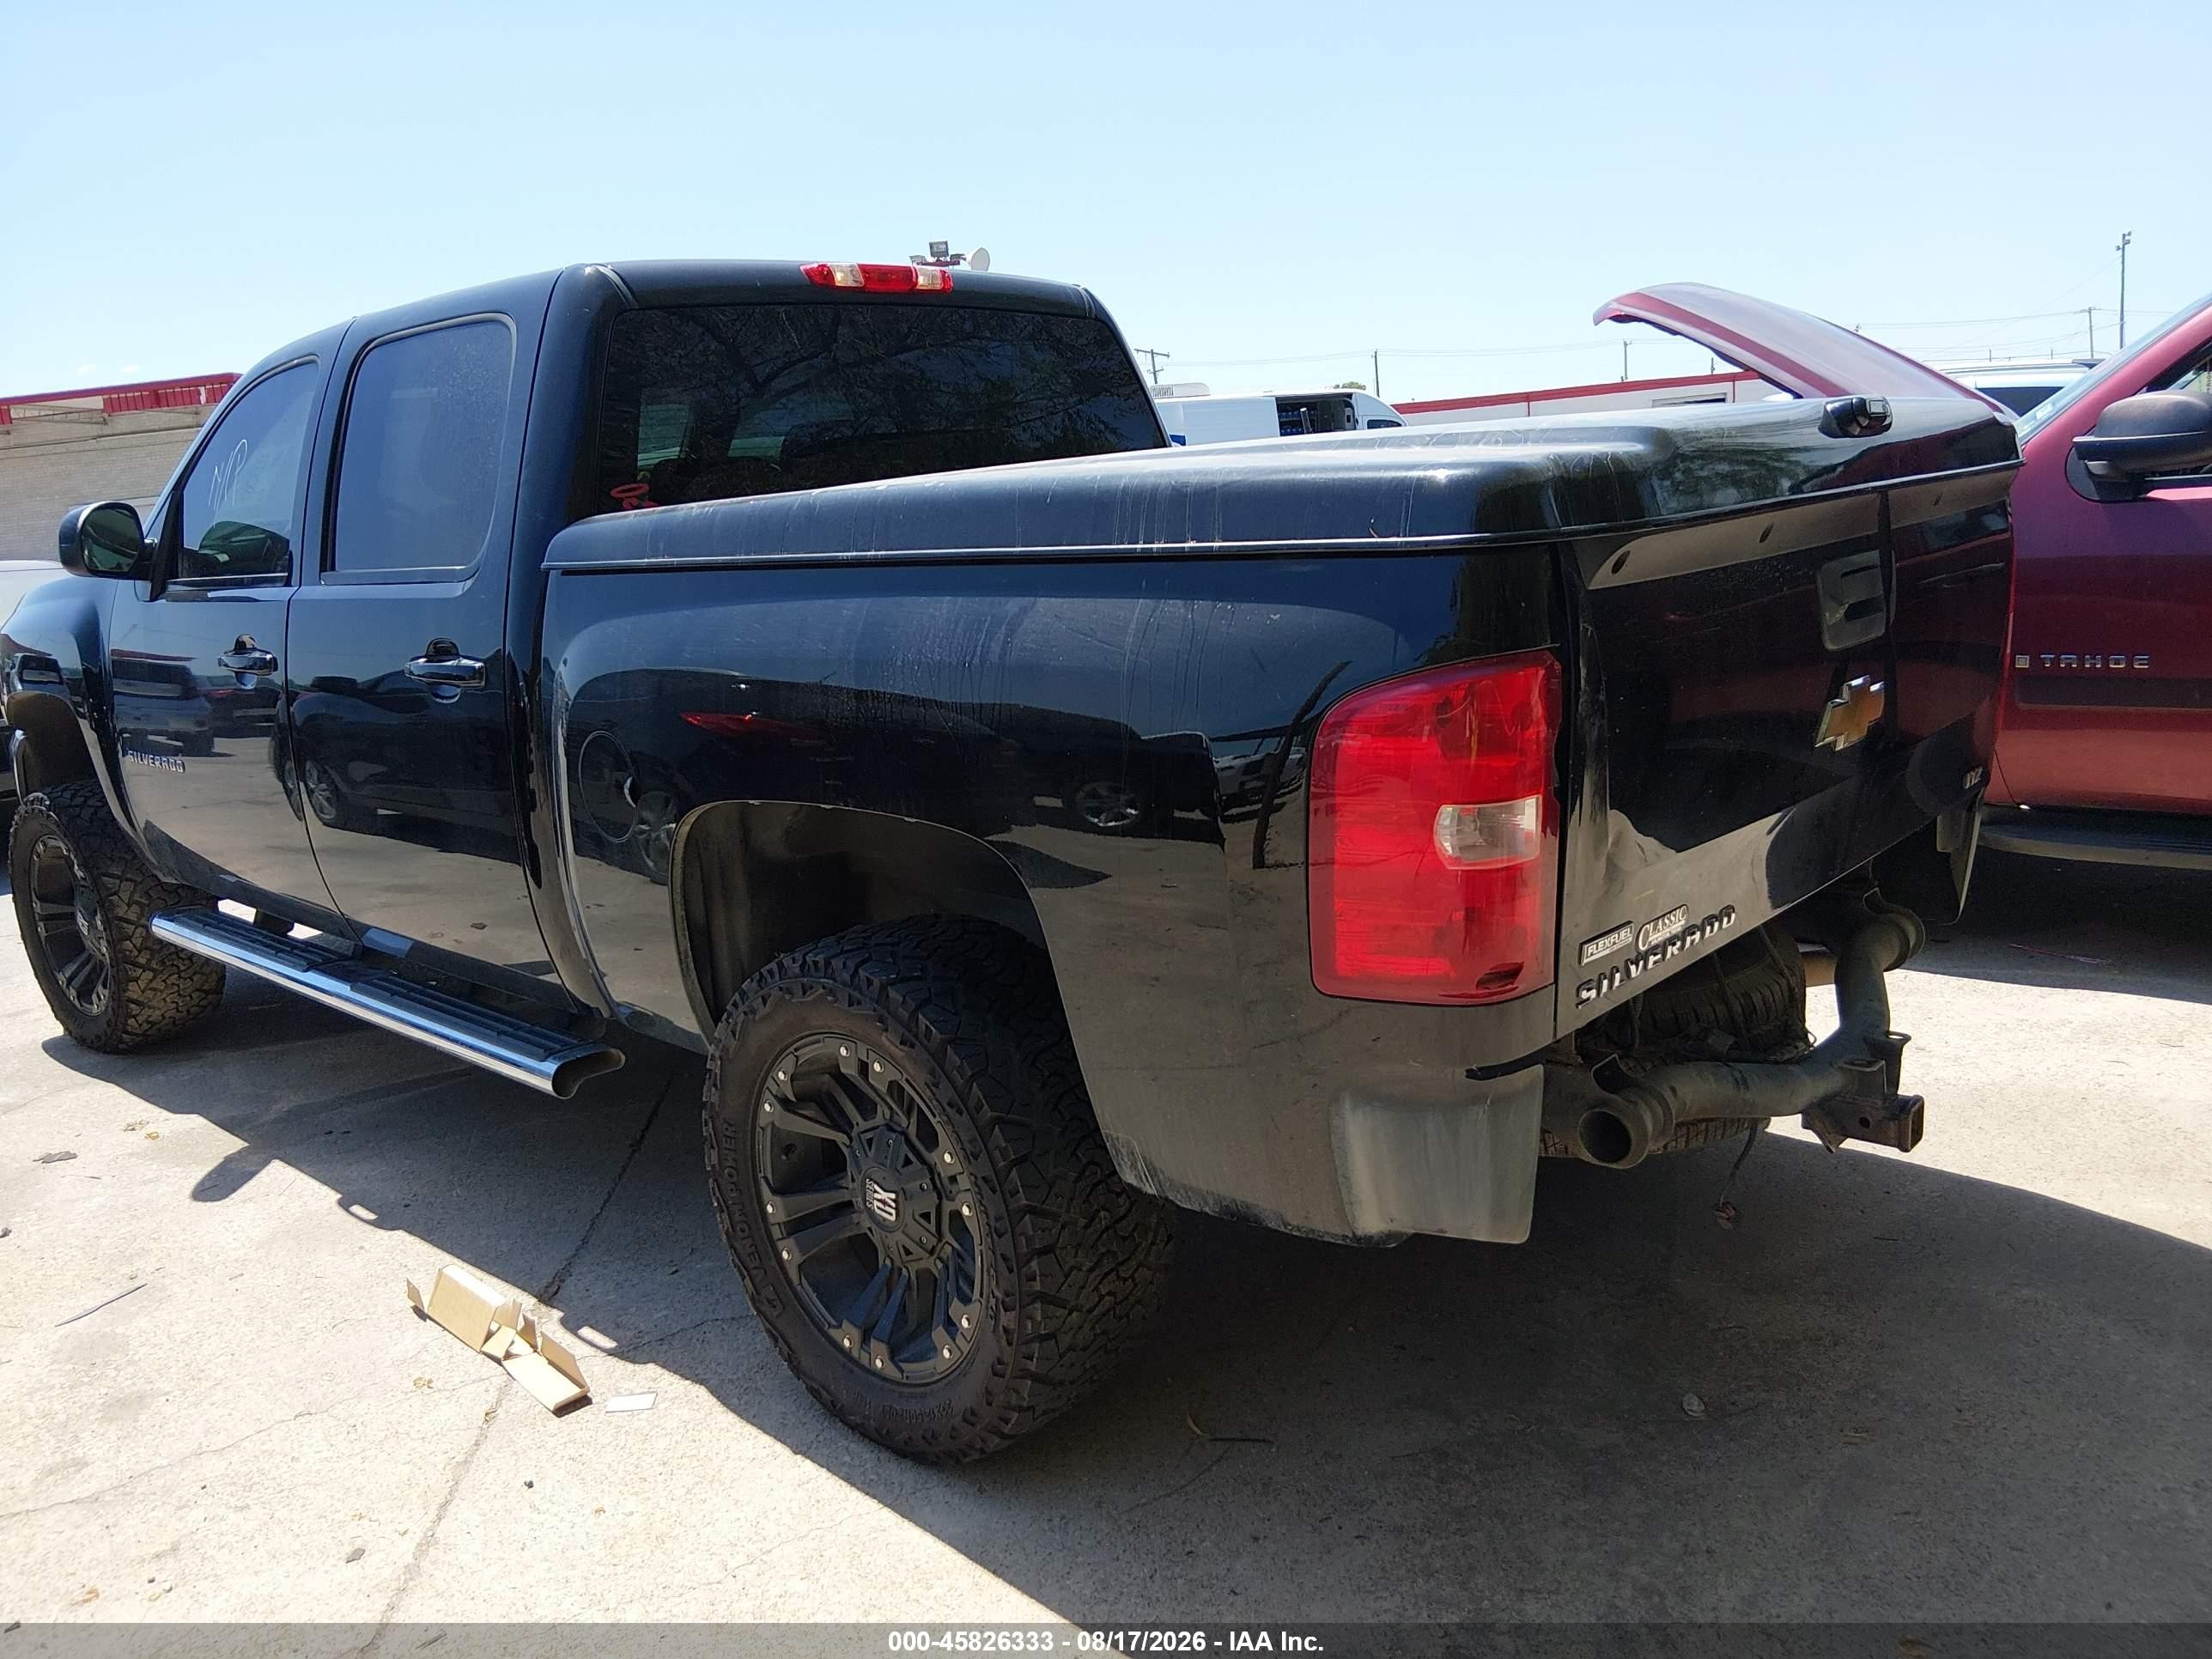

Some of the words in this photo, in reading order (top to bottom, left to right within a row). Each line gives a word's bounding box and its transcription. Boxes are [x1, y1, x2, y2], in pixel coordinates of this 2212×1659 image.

[2040, 654, 2149, 668] TAHOE
[127, 750, 185, 774] SILVERADO
[1587, 927, 1632, 957] FLEXFUEL
[1638, 905, 1688, 951] CLASSIC
[1576, 905, 1735, 1008] SILVERADO
[723, 1117, 741, 1196] POWER
[866, 1177, 874, 1210] SERIES
[873, 1183, 896, 1221] XD
[733, 1201, 767, 1279] VENOM
